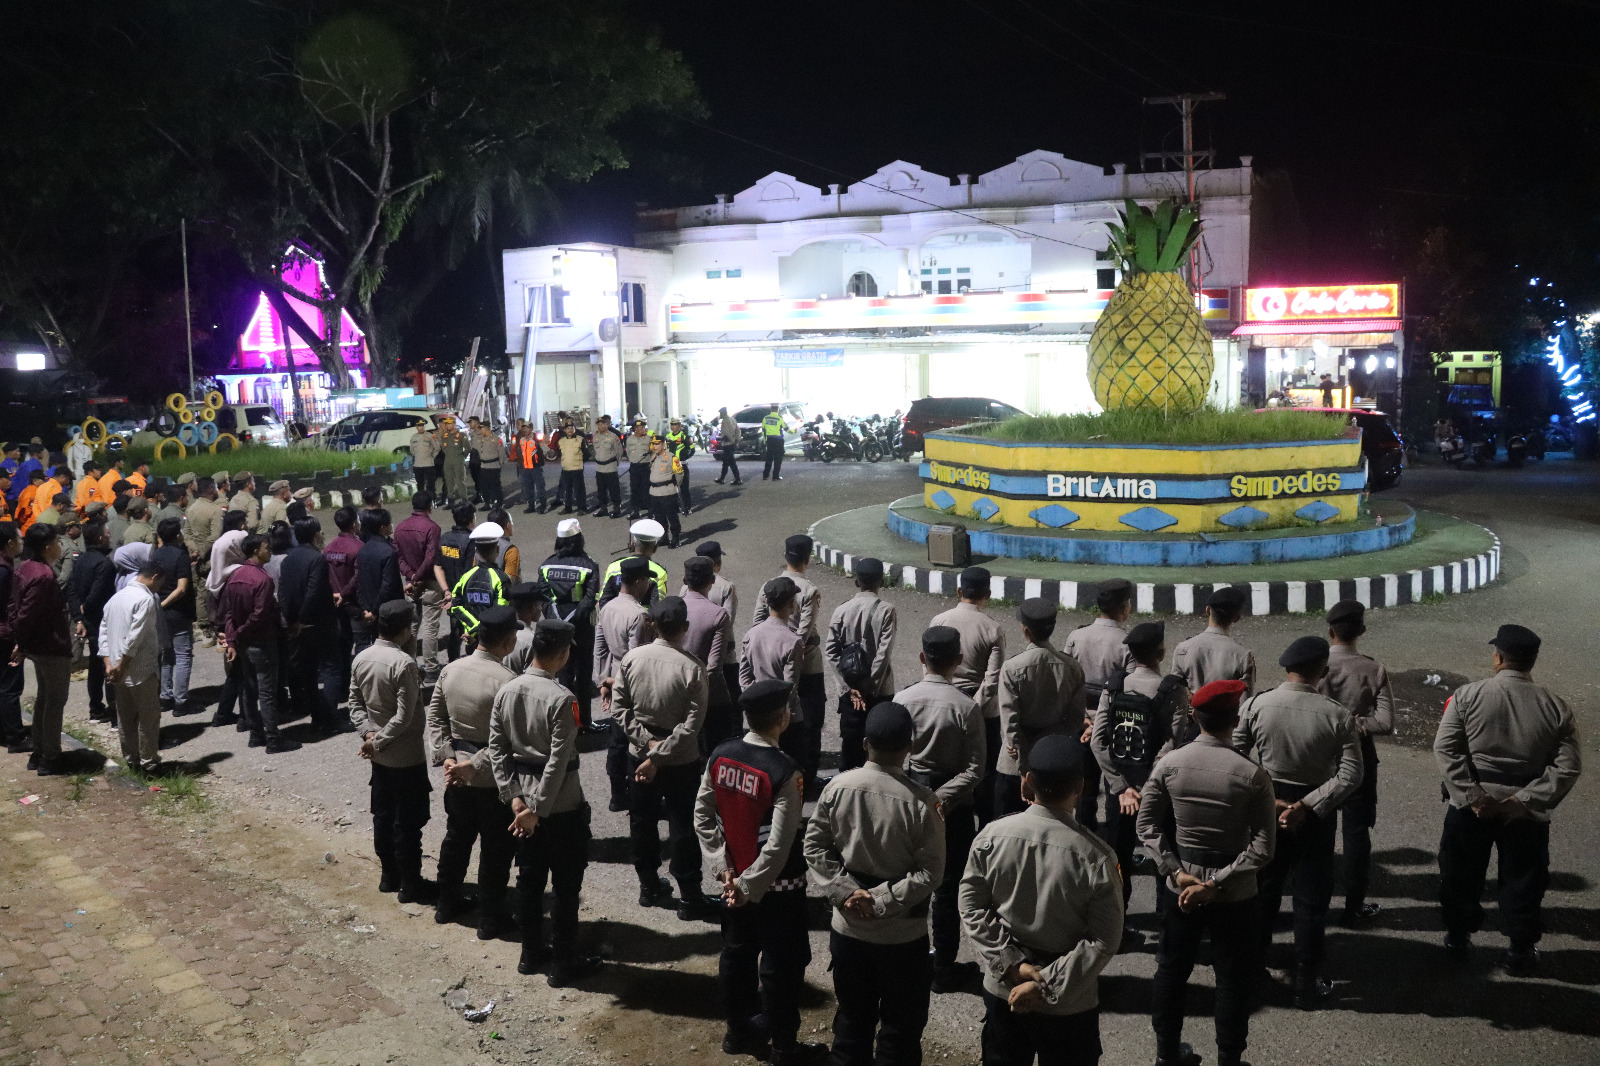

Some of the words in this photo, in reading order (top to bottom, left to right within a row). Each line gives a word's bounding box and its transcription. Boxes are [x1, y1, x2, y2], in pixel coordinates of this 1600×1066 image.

[776, 352, 801, 360] PARKIR
[801, 351, 827, 360] GRATIS
[930, 460, 990, 490] Simpedes
[1047, 474, 1157, 499] BritAma
[1231, 471, 1341, 499] Simpedes
[547, 570, 580, 580] POLISI
[467, 592, 490, 604] POLISI
[1116, 711, 1144, 721] POLISI
[717, 765, 760, 797] POLISI
